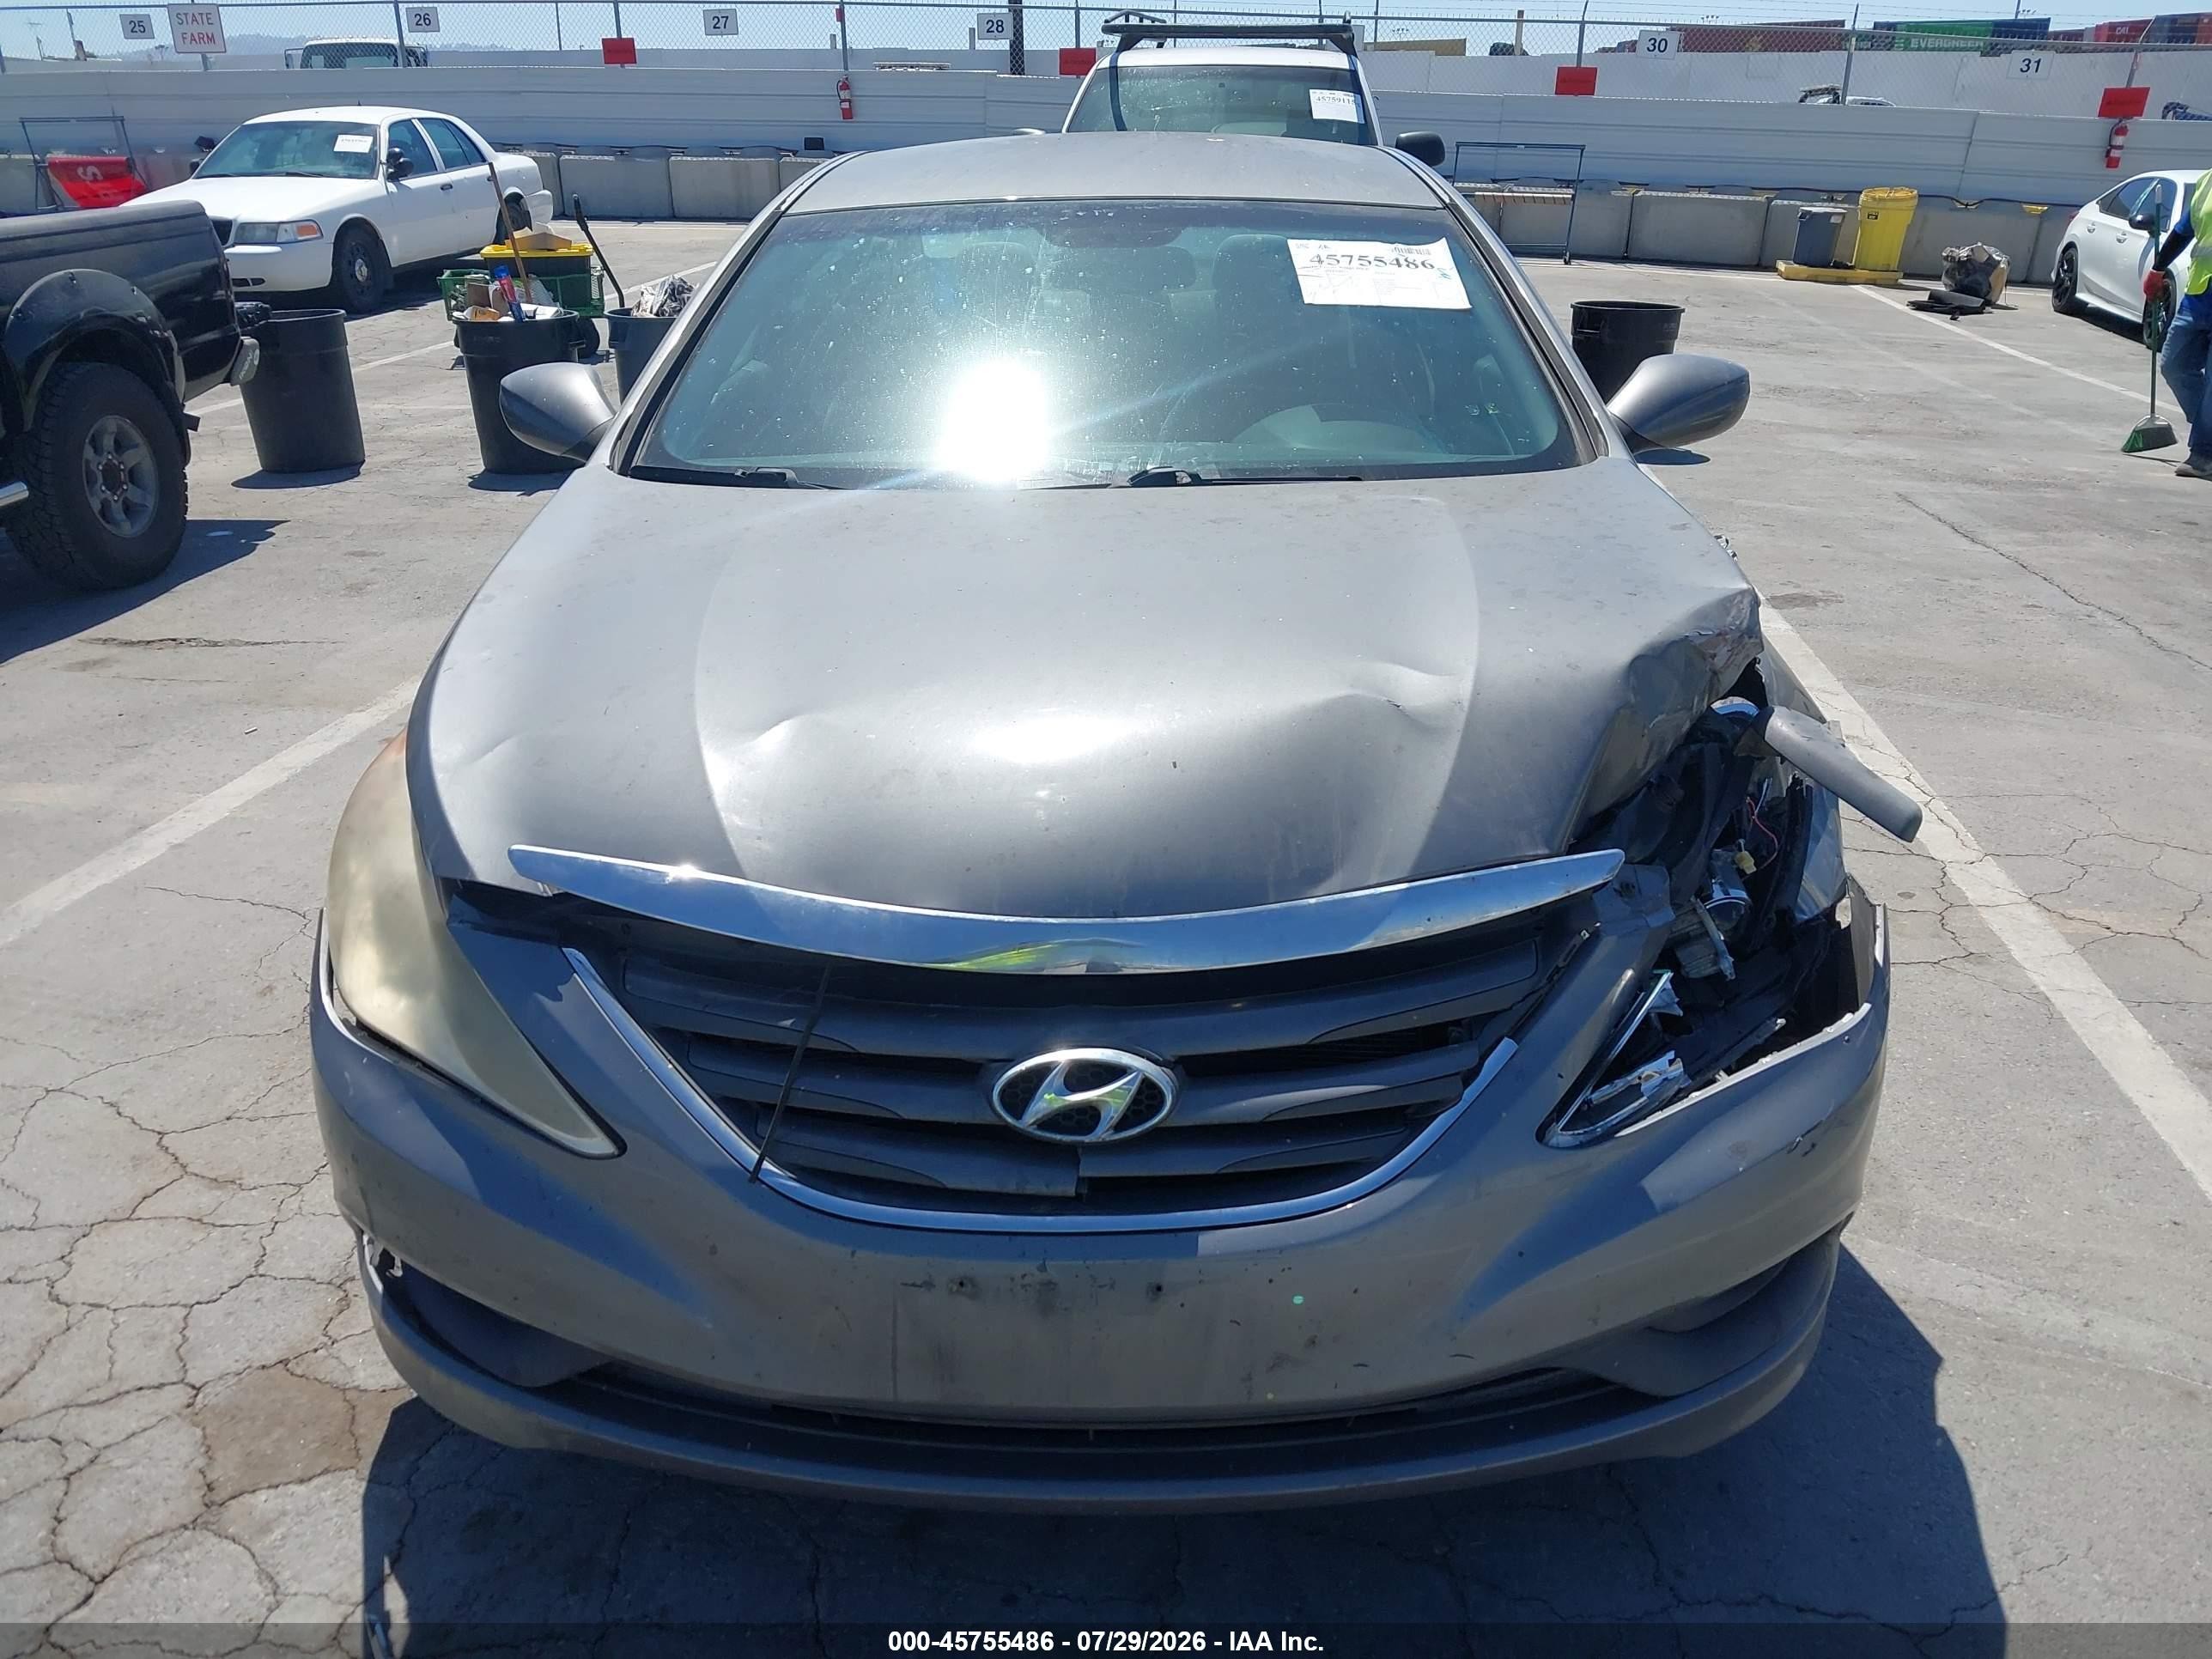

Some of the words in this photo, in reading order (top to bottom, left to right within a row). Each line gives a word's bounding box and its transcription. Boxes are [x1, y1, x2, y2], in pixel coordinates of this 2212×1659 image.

[175, 12, 214, 26] STATE
[414, 13, 431, 27] 26
[712, 15, 729, 29] 27
[986, 19, 1005, 33] 28
[129, 20, 146, 33] 25
[181, 32, 216, 45] FARM
[1646, 37, 1668, 53] 30
[2020, 58, 2042, 74] 31
[1309, 254, 1435, 270] 45755486
